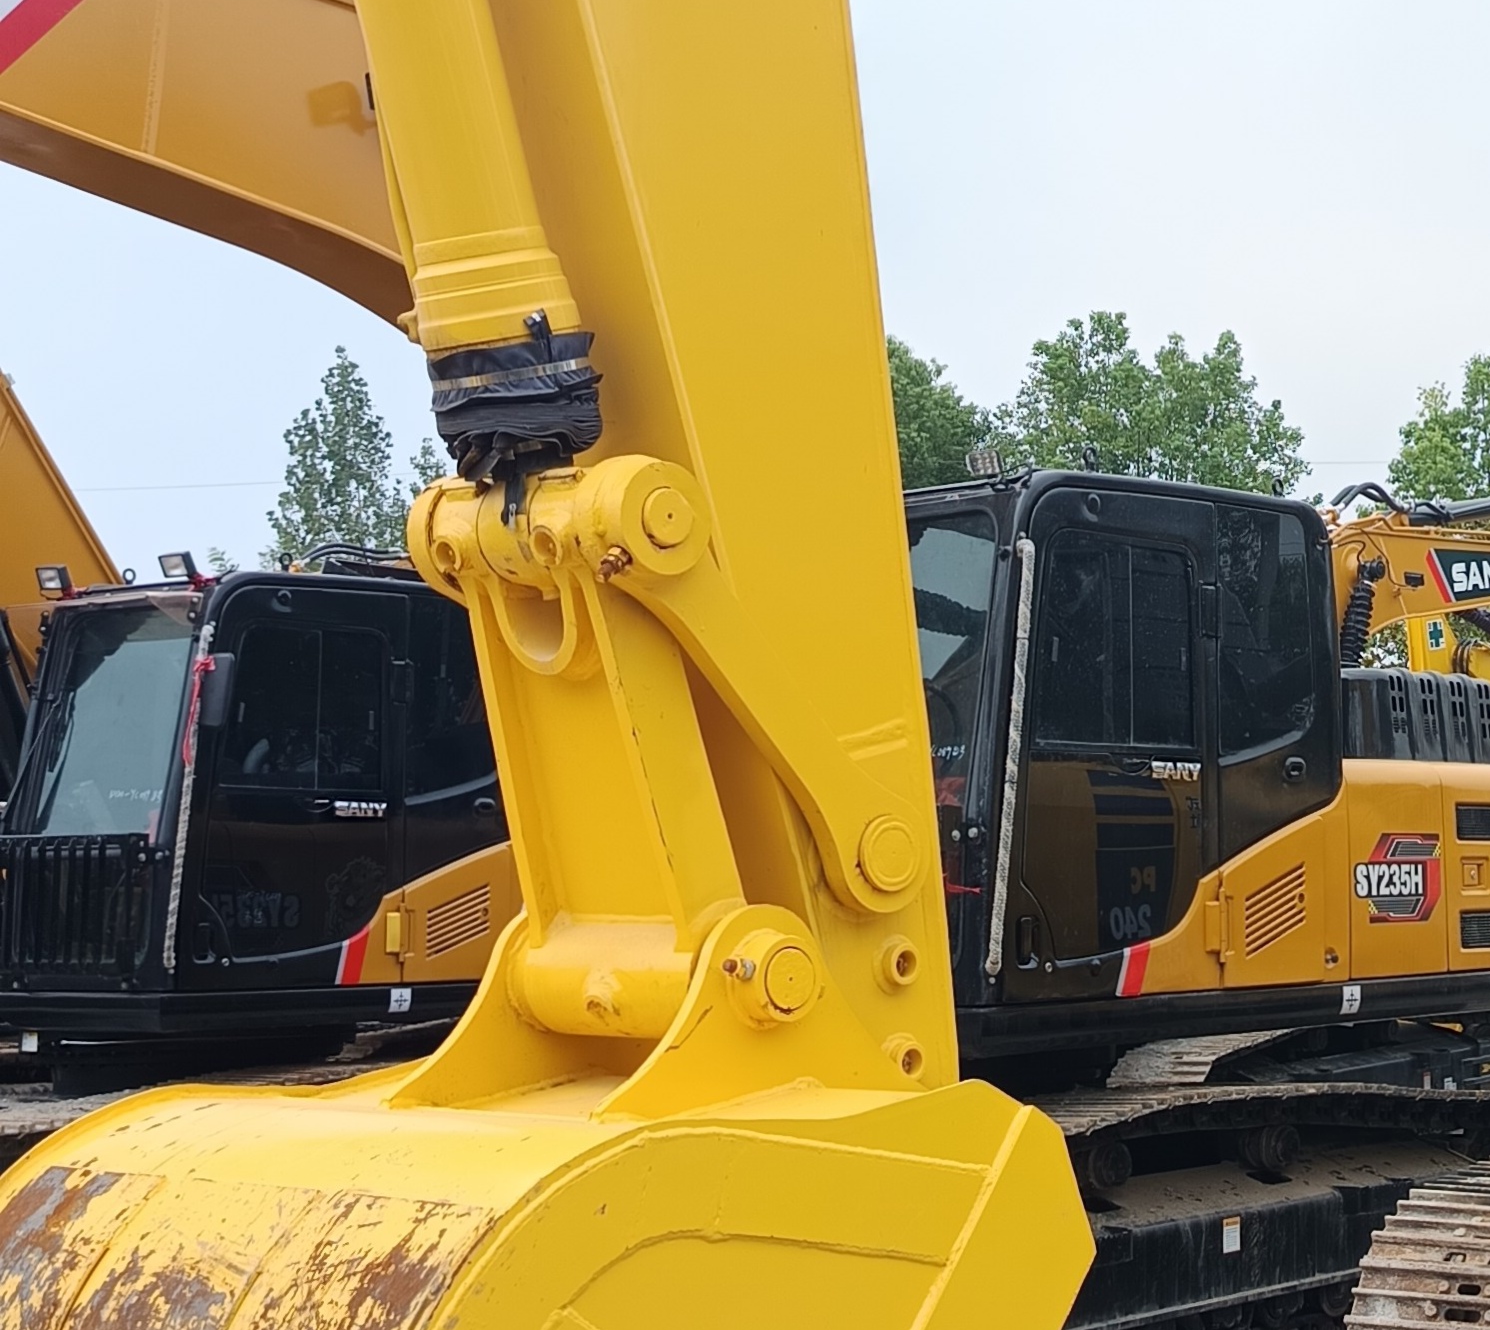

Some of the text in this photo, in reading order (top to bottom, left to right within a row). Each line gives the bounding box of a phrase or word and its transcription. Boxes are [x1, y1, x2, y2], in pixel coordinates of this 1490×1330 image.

[1151, 760, 1201, 782] SANY
[334, 801, 387, 817] SANY
[1355, 863, 1424, 897] SY235H
